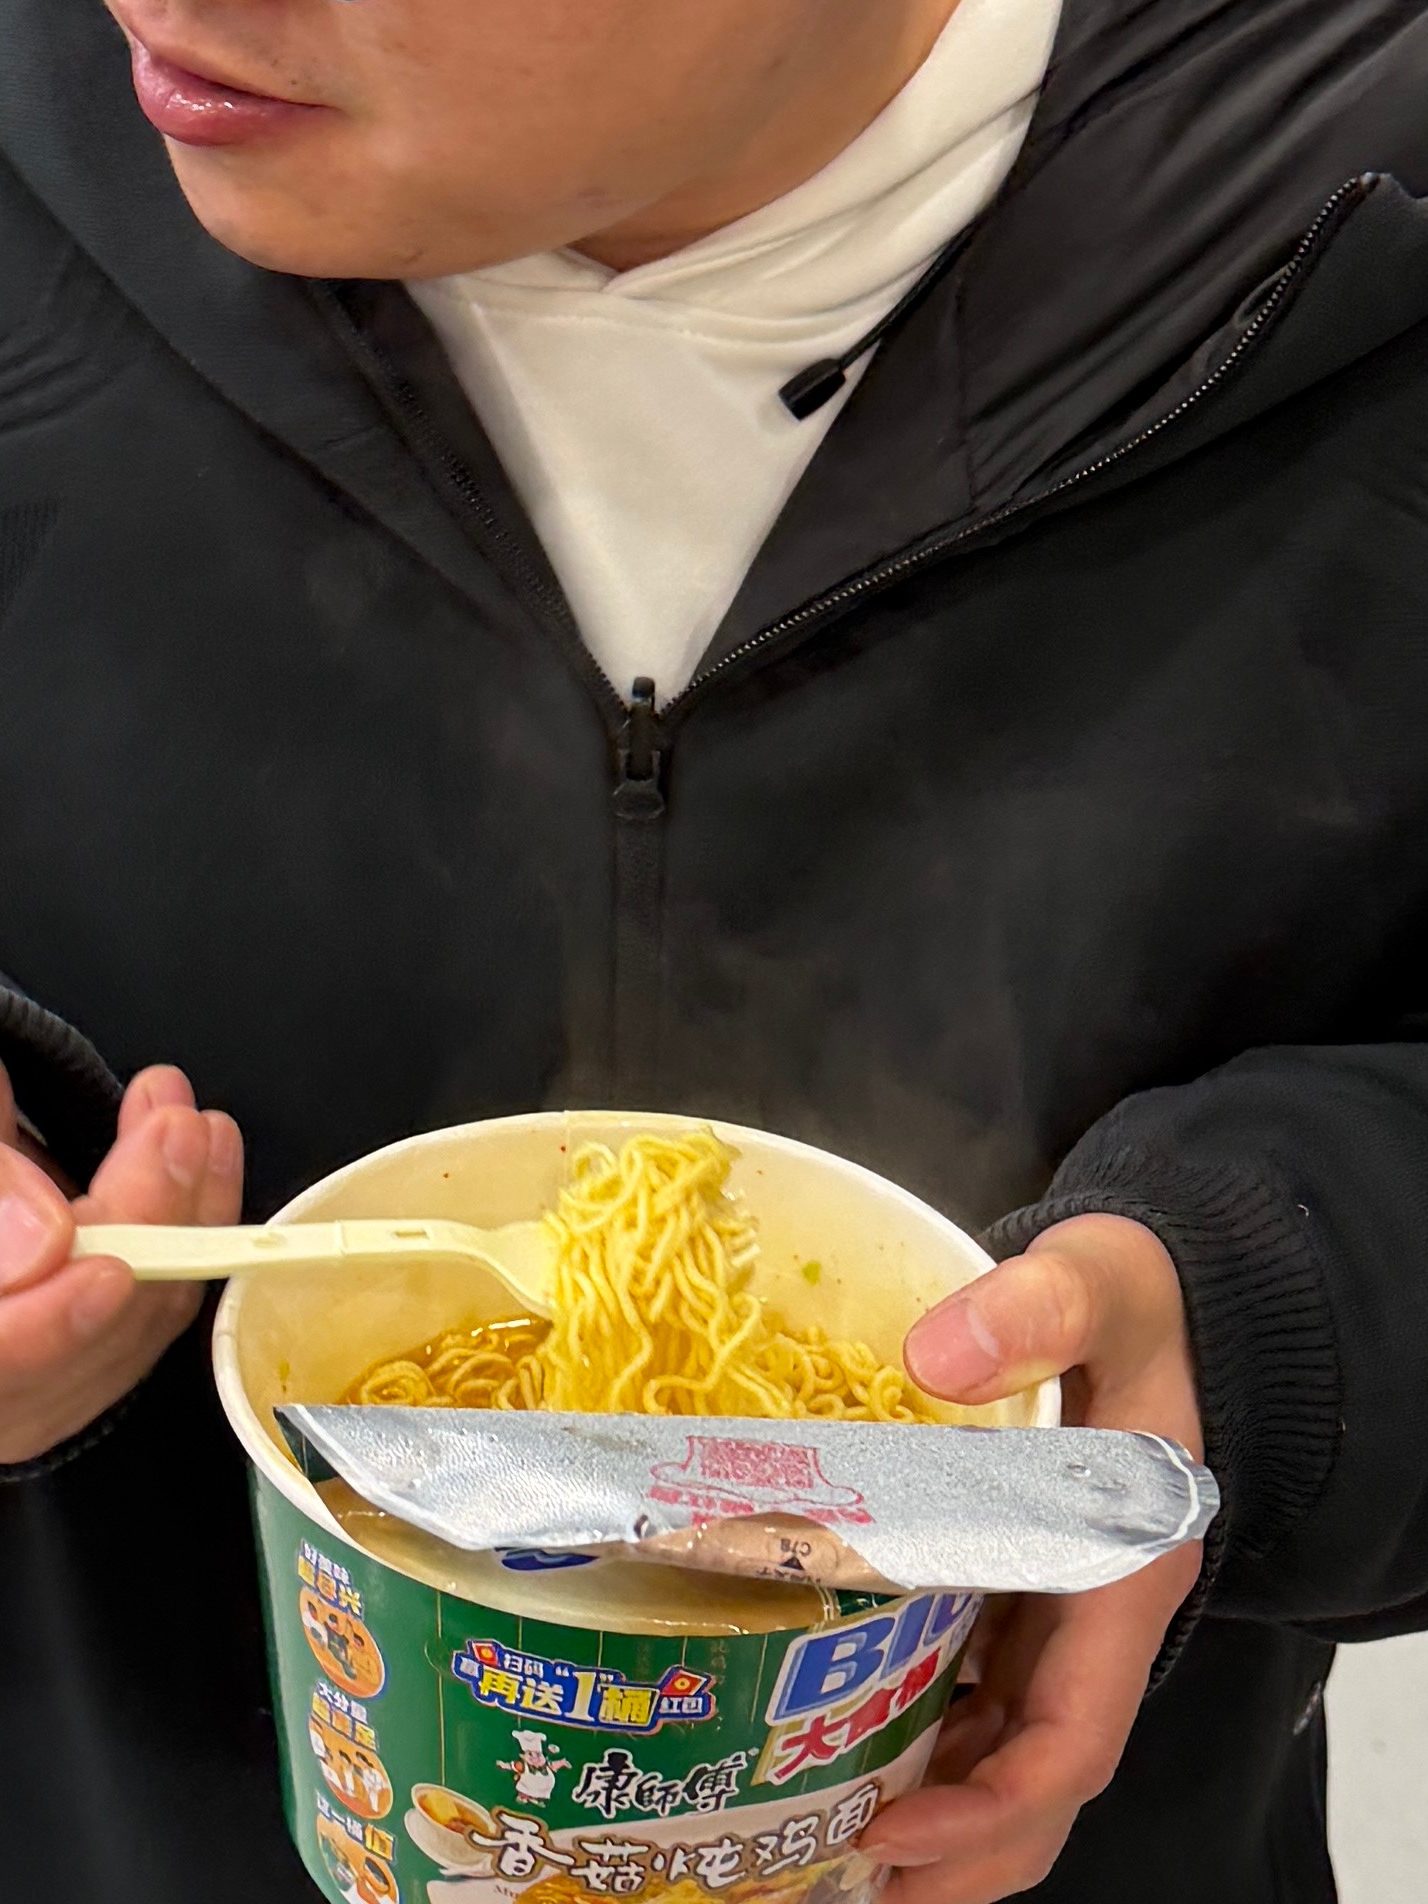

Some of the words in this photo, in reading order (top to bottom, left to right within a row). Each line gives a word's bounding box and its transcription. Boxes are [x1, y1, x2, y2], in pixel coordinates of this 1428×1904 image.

[470, 1783, 880, 1893] 香菇炖鸡面
